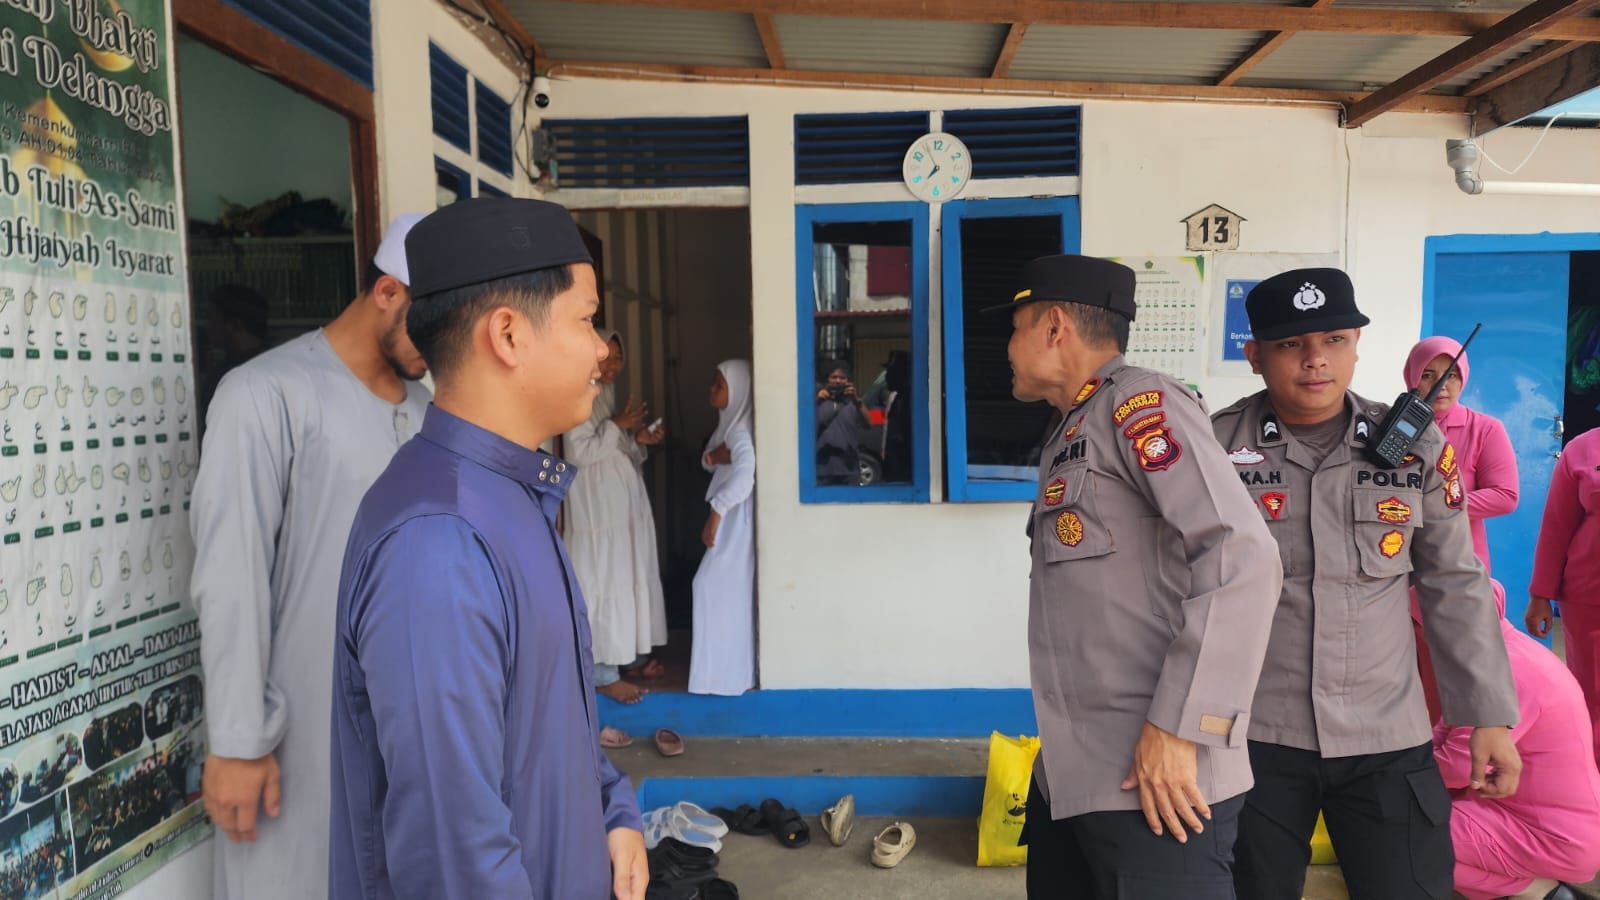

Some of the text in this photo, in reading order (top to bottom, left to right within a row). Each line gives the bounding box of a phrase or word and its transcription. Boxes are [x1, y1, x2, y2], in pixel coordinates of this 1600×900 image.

[66, 0, 158, 73] Bhakti
[23, 35, 172, 136] Delangga
[934, 140, 943, 151] 12
[28, 167, 75, 210] Tuli
[82, 181, 175, 231] As-Sami
[1199, 216, 1229, 244] 13
[1, 216, 174, 277] Hijaiyah Isyarat
[11, 663, 78, 709] HADIST
[90, 643, 135, 680] AMAL
[53, 690, 99, 726] AGAMA
[98, 674, 138, 706] UNTUK
